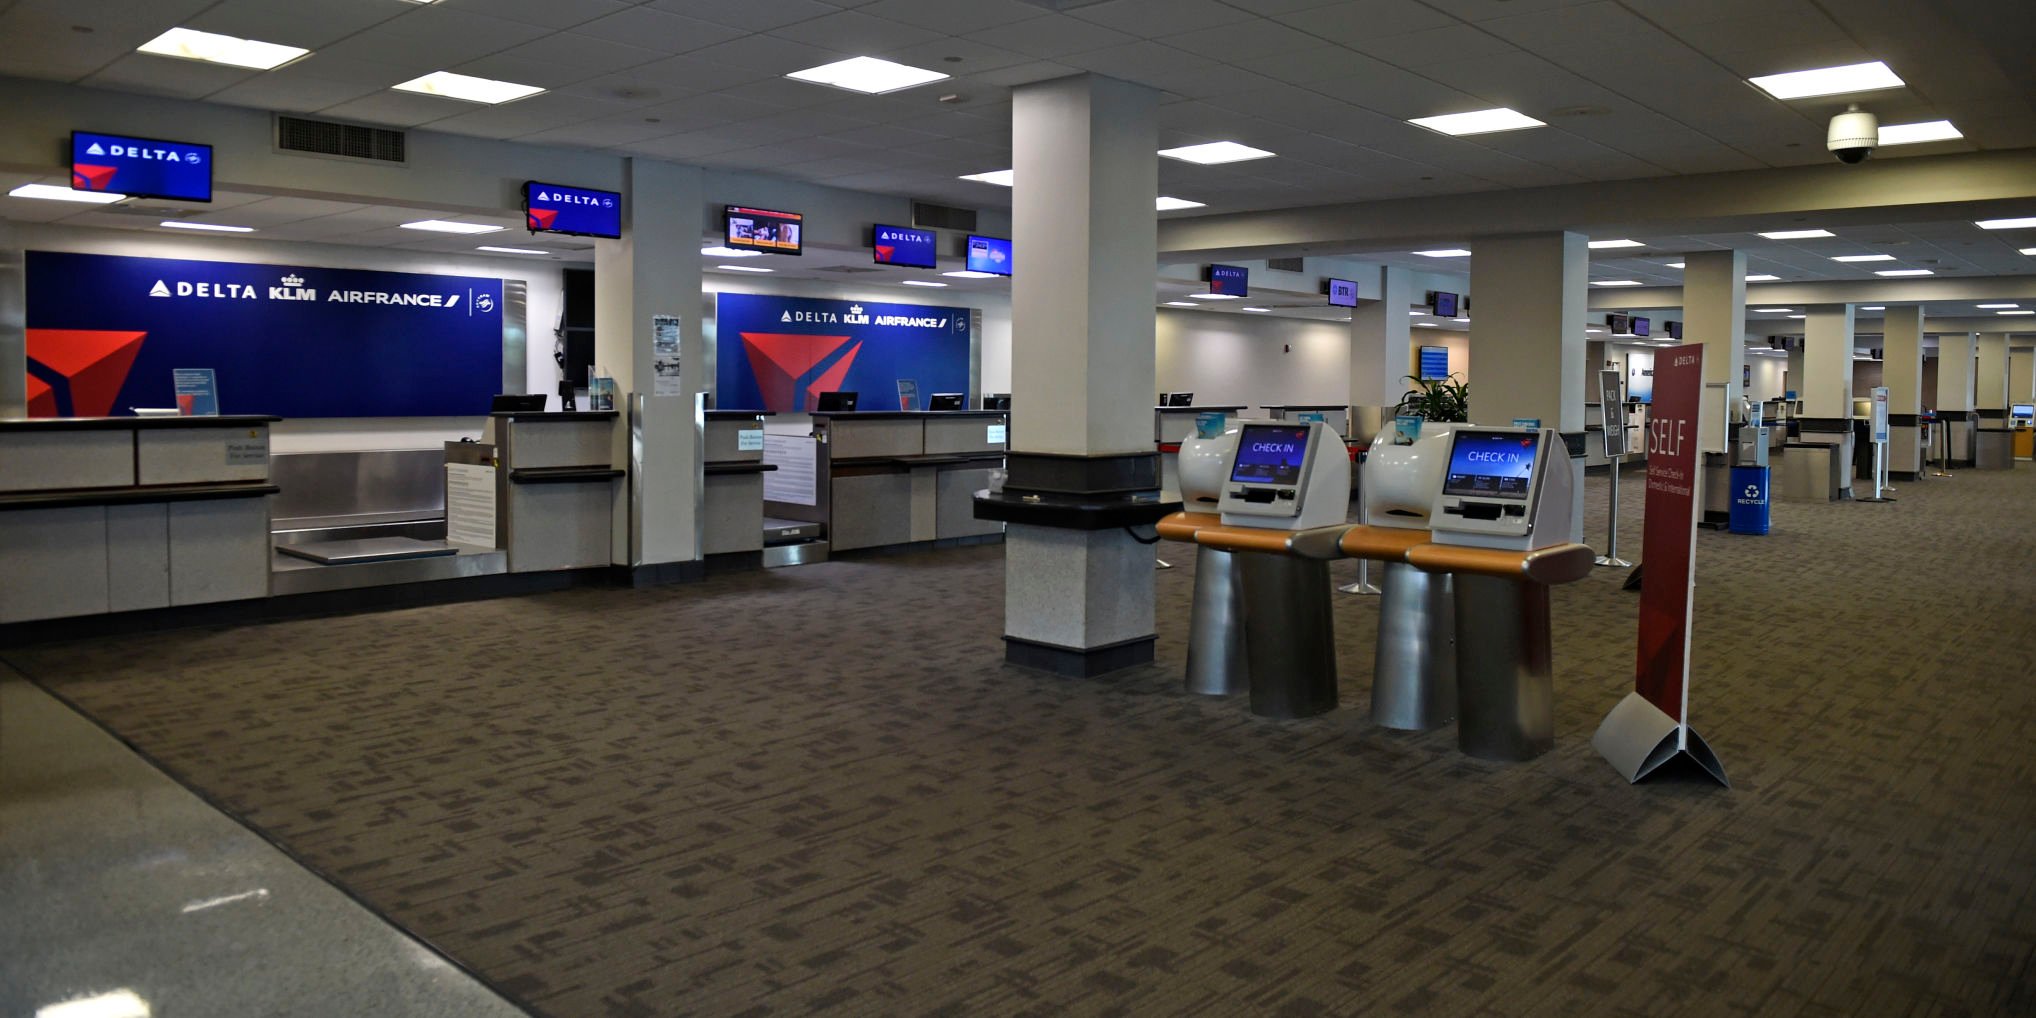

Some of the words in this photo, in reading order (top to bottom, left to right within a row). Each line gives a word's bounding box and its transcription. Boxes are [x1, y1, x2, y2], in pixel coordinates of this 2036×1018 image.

[110, 144, 181, 162] DELTA
[553, 193, 599, 207] DELTA
[891, 232, 922, 243] DELTA
[1220, 270, 1240, 278] DELTA
[177, 281, 257, 299] DELTA
[268, 287, 317, 301] KLM
[327, 289, 443, 307] AIRFRANCE
[1338, 286, 1349, 297] BTR
[795, 311, 838, 323] DELTA
[843, 314, 869, 325] KLM
[874, 316, 938, 328] AIRFRANCE
[1678, 355, 1695, 366] DELTA
[1650, 418, 1686, 456] SELF
[1252, 442, 1282, 453] CHECK
[1283, 444, 1294, 453] IN
[1467, 451, 1505, 463] CHECK
[1507, 453, 1520, 463] IN
